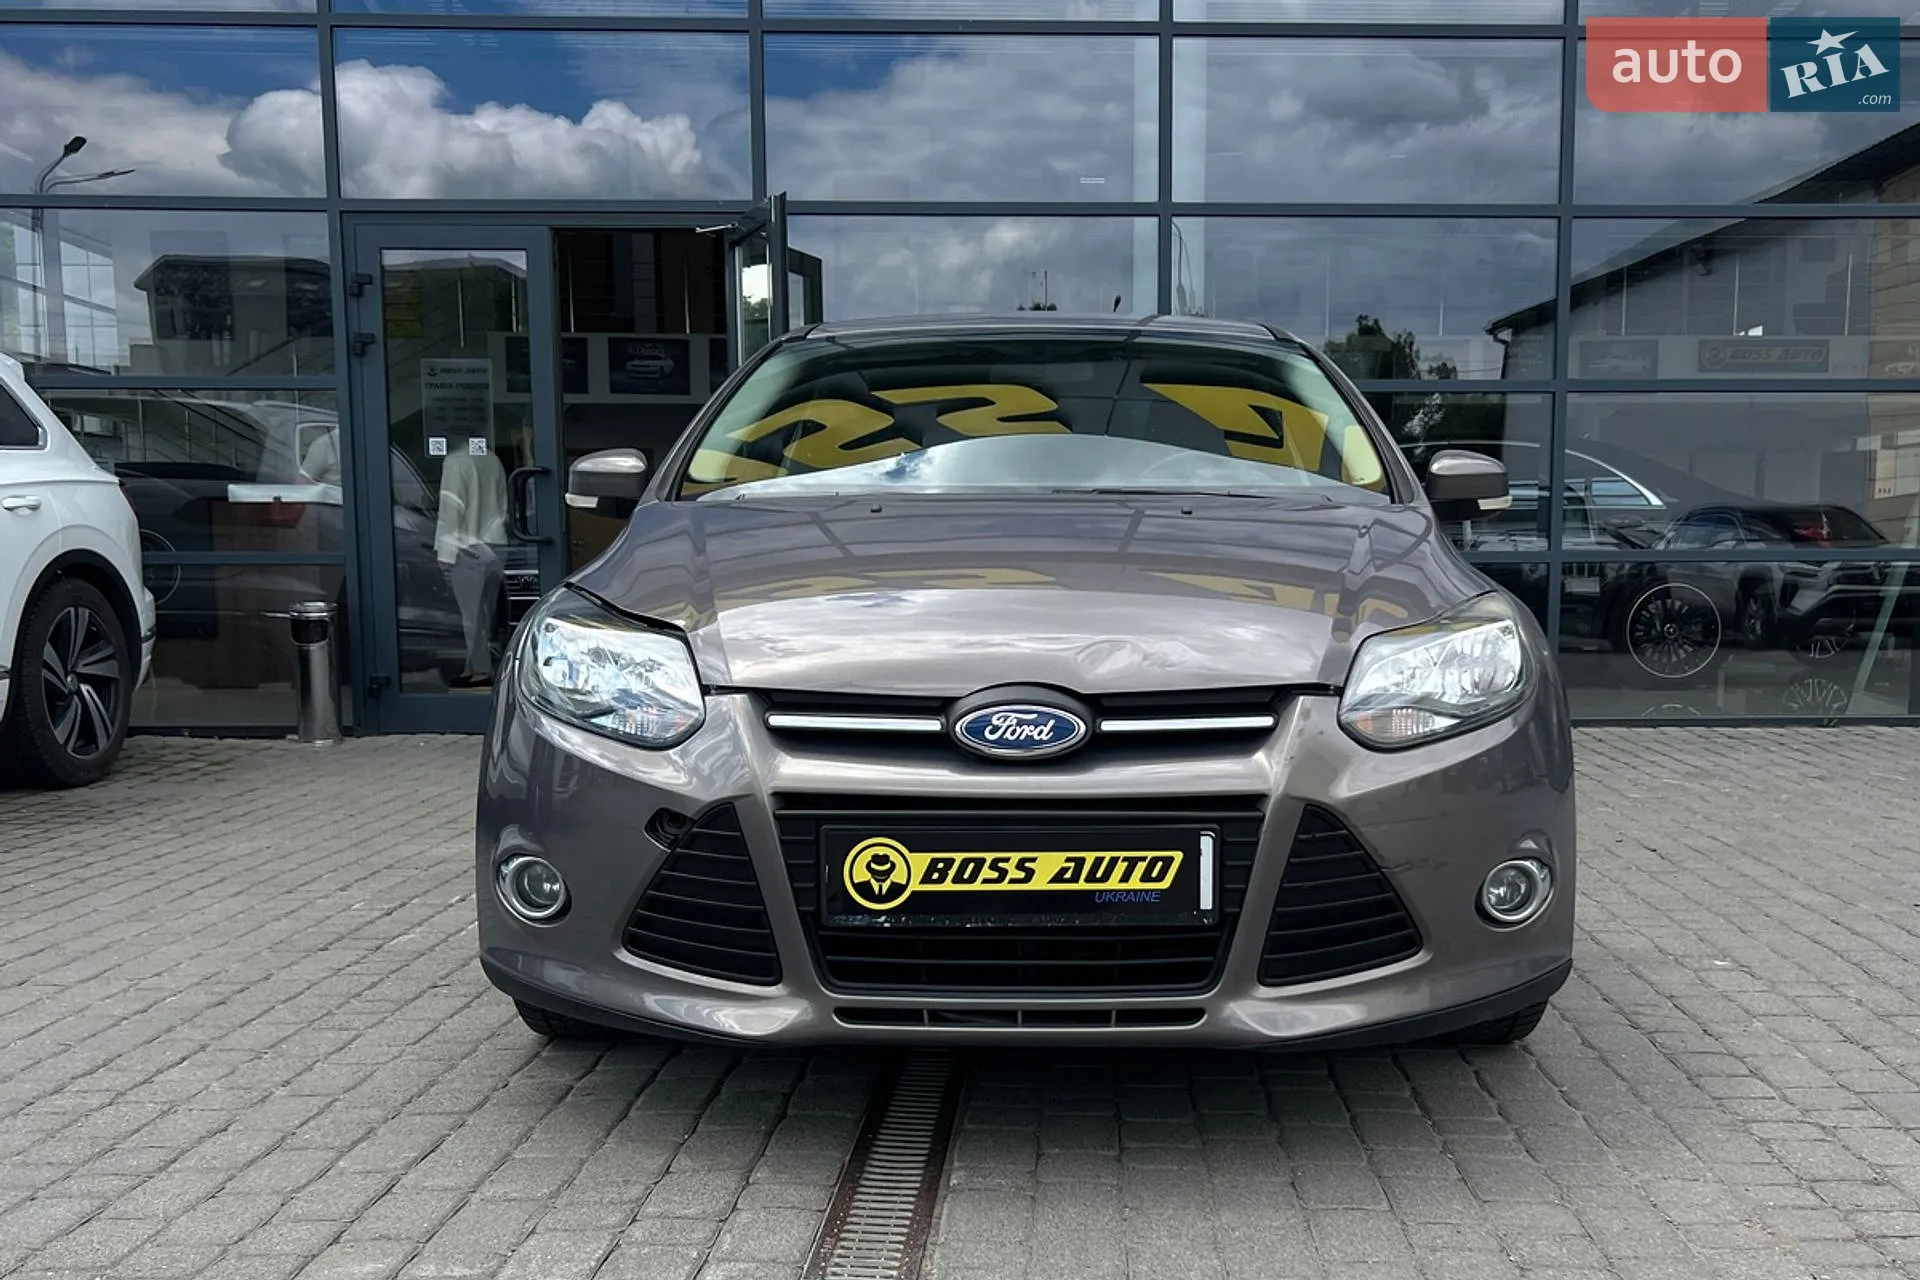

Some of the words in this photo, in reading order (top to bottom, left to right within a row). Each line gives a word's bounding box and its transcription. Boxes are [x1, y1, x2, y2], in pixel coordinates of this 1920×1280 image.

[984, 712, 1055, 740] Ford
[918, 857, 1038, 885] BOSS
[1046, 856, 1176, 884] AUTO
[1095, 891, 1161, 902] UKRAINE
